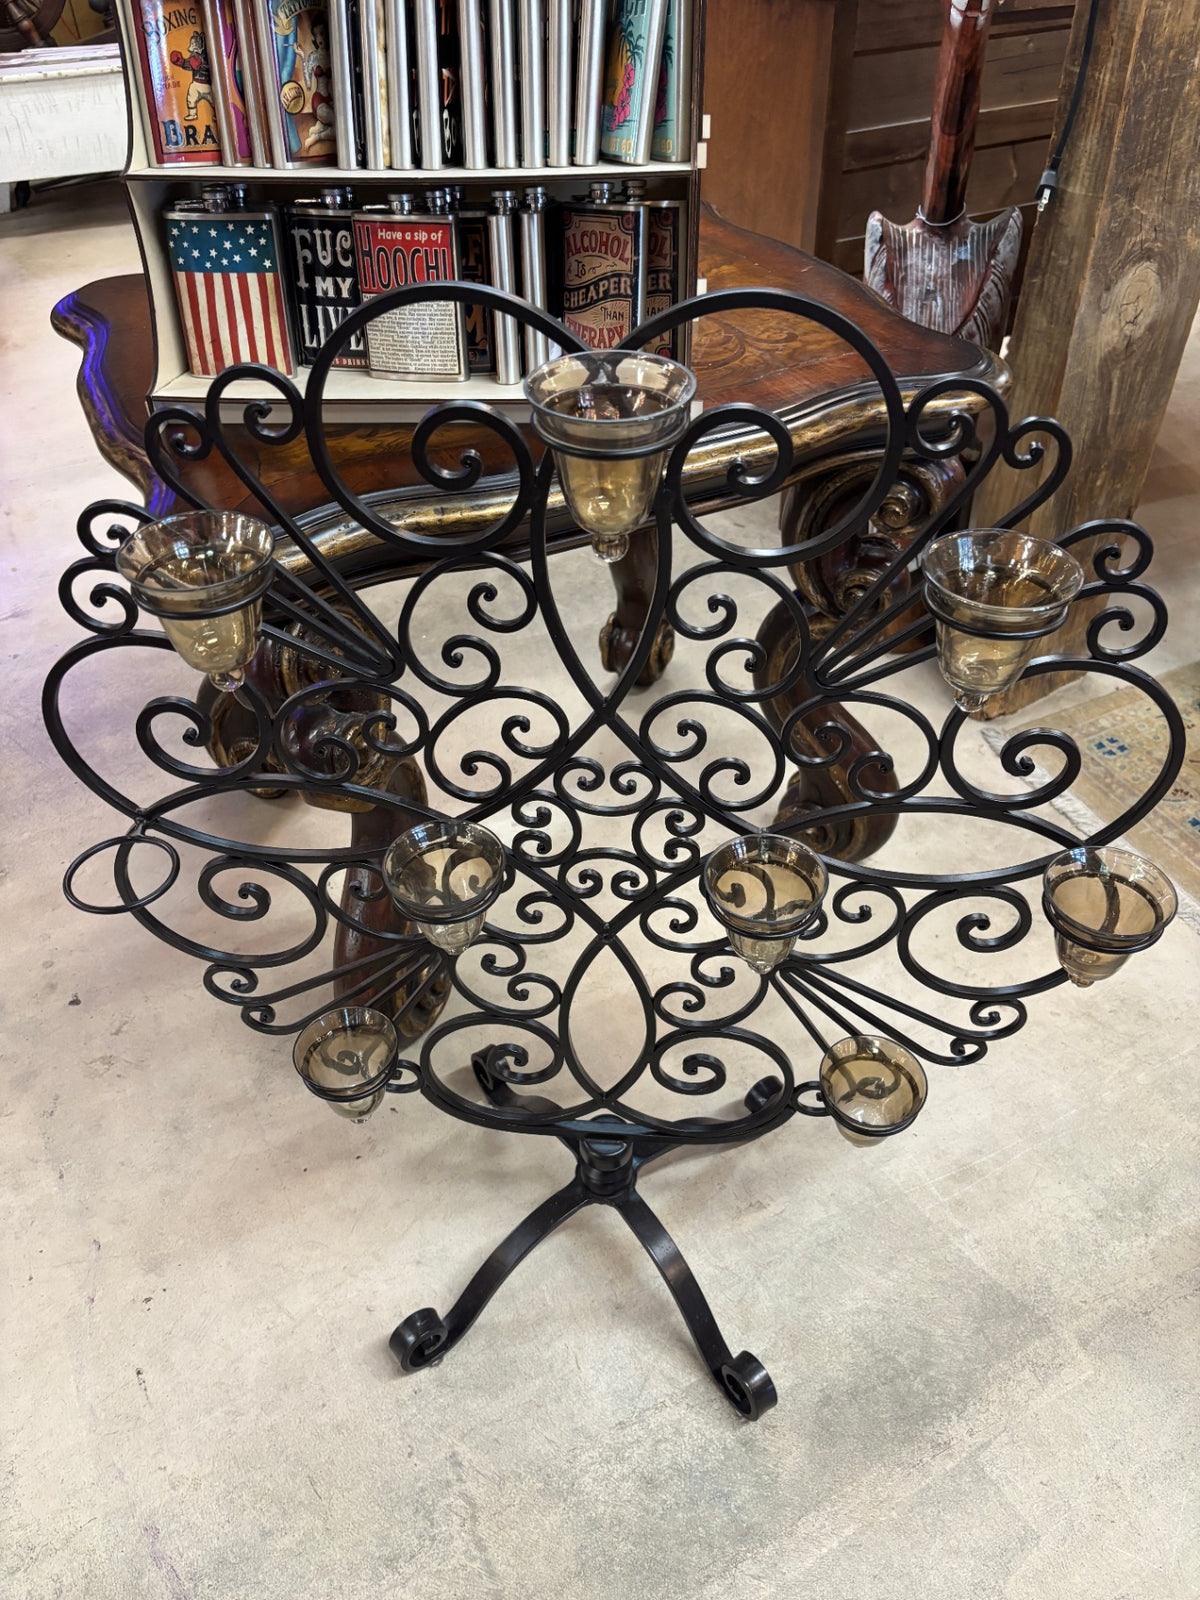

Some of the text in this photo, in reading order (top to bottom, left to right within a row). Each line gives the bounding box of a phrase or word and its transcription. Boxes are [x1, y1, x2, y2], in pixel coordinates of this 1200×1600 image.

[162, 120, 217, 149] BRA
[377, 228, 443, 244] Have a sip of
[566, 230, 630, 265] ALCOHOL
[291, 227, 353, 289] FUC
[315, 276, 355, 299] MY
[564, 277, 633, 308] CHEAPER
[600, 306, 624, 321] THAN
[567, 316, 625, 349] THERAPY
